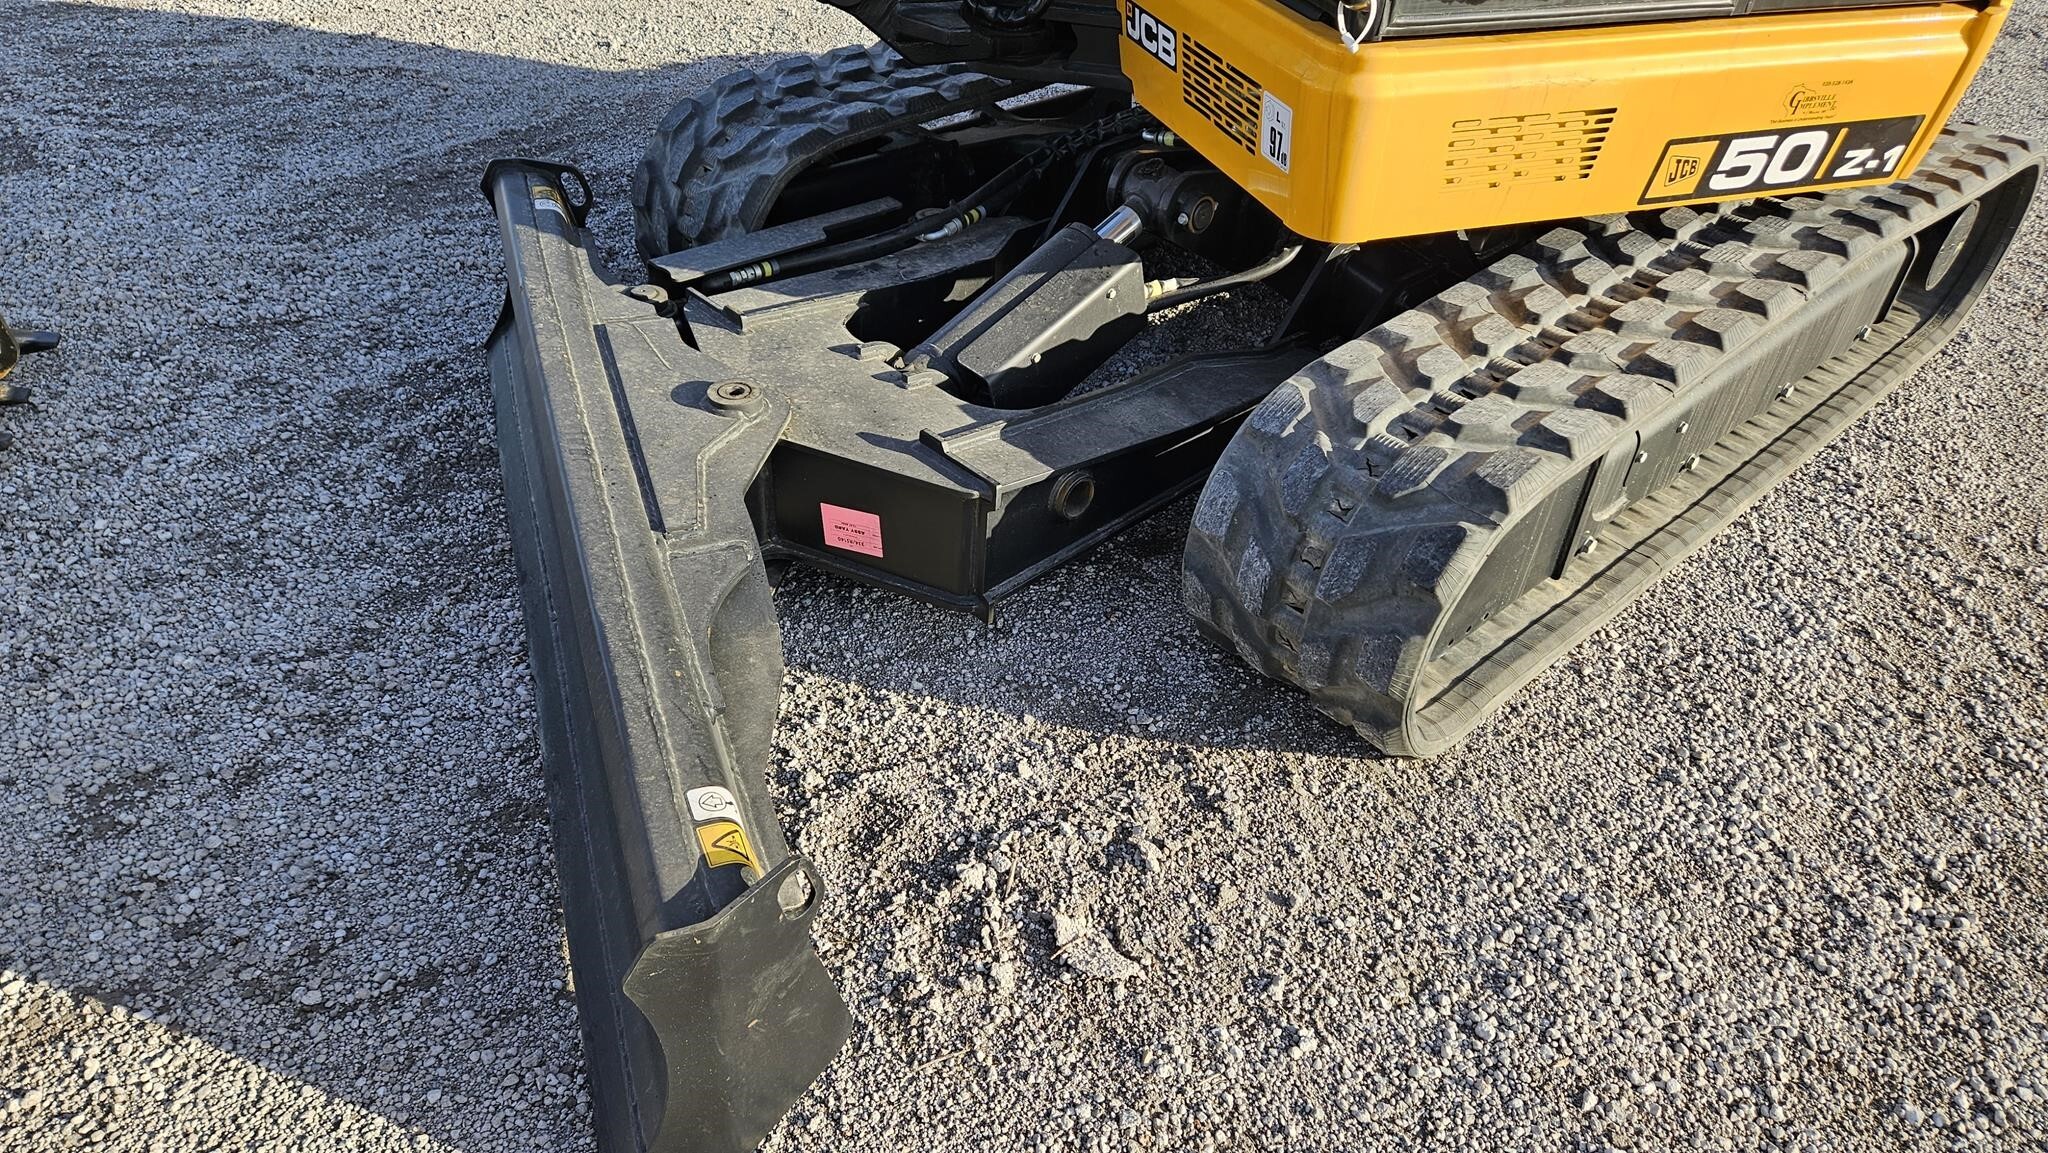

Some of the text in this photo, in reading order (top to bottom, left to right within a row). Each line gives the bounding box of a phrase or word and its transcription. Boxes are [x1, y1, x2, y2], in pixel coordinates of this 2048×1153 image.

[1126, 6, 1176, 67] JCB
[1269, 126, 1283, 162] 97
[1668, 130, 1907, 191] JCB 50 Z-1
